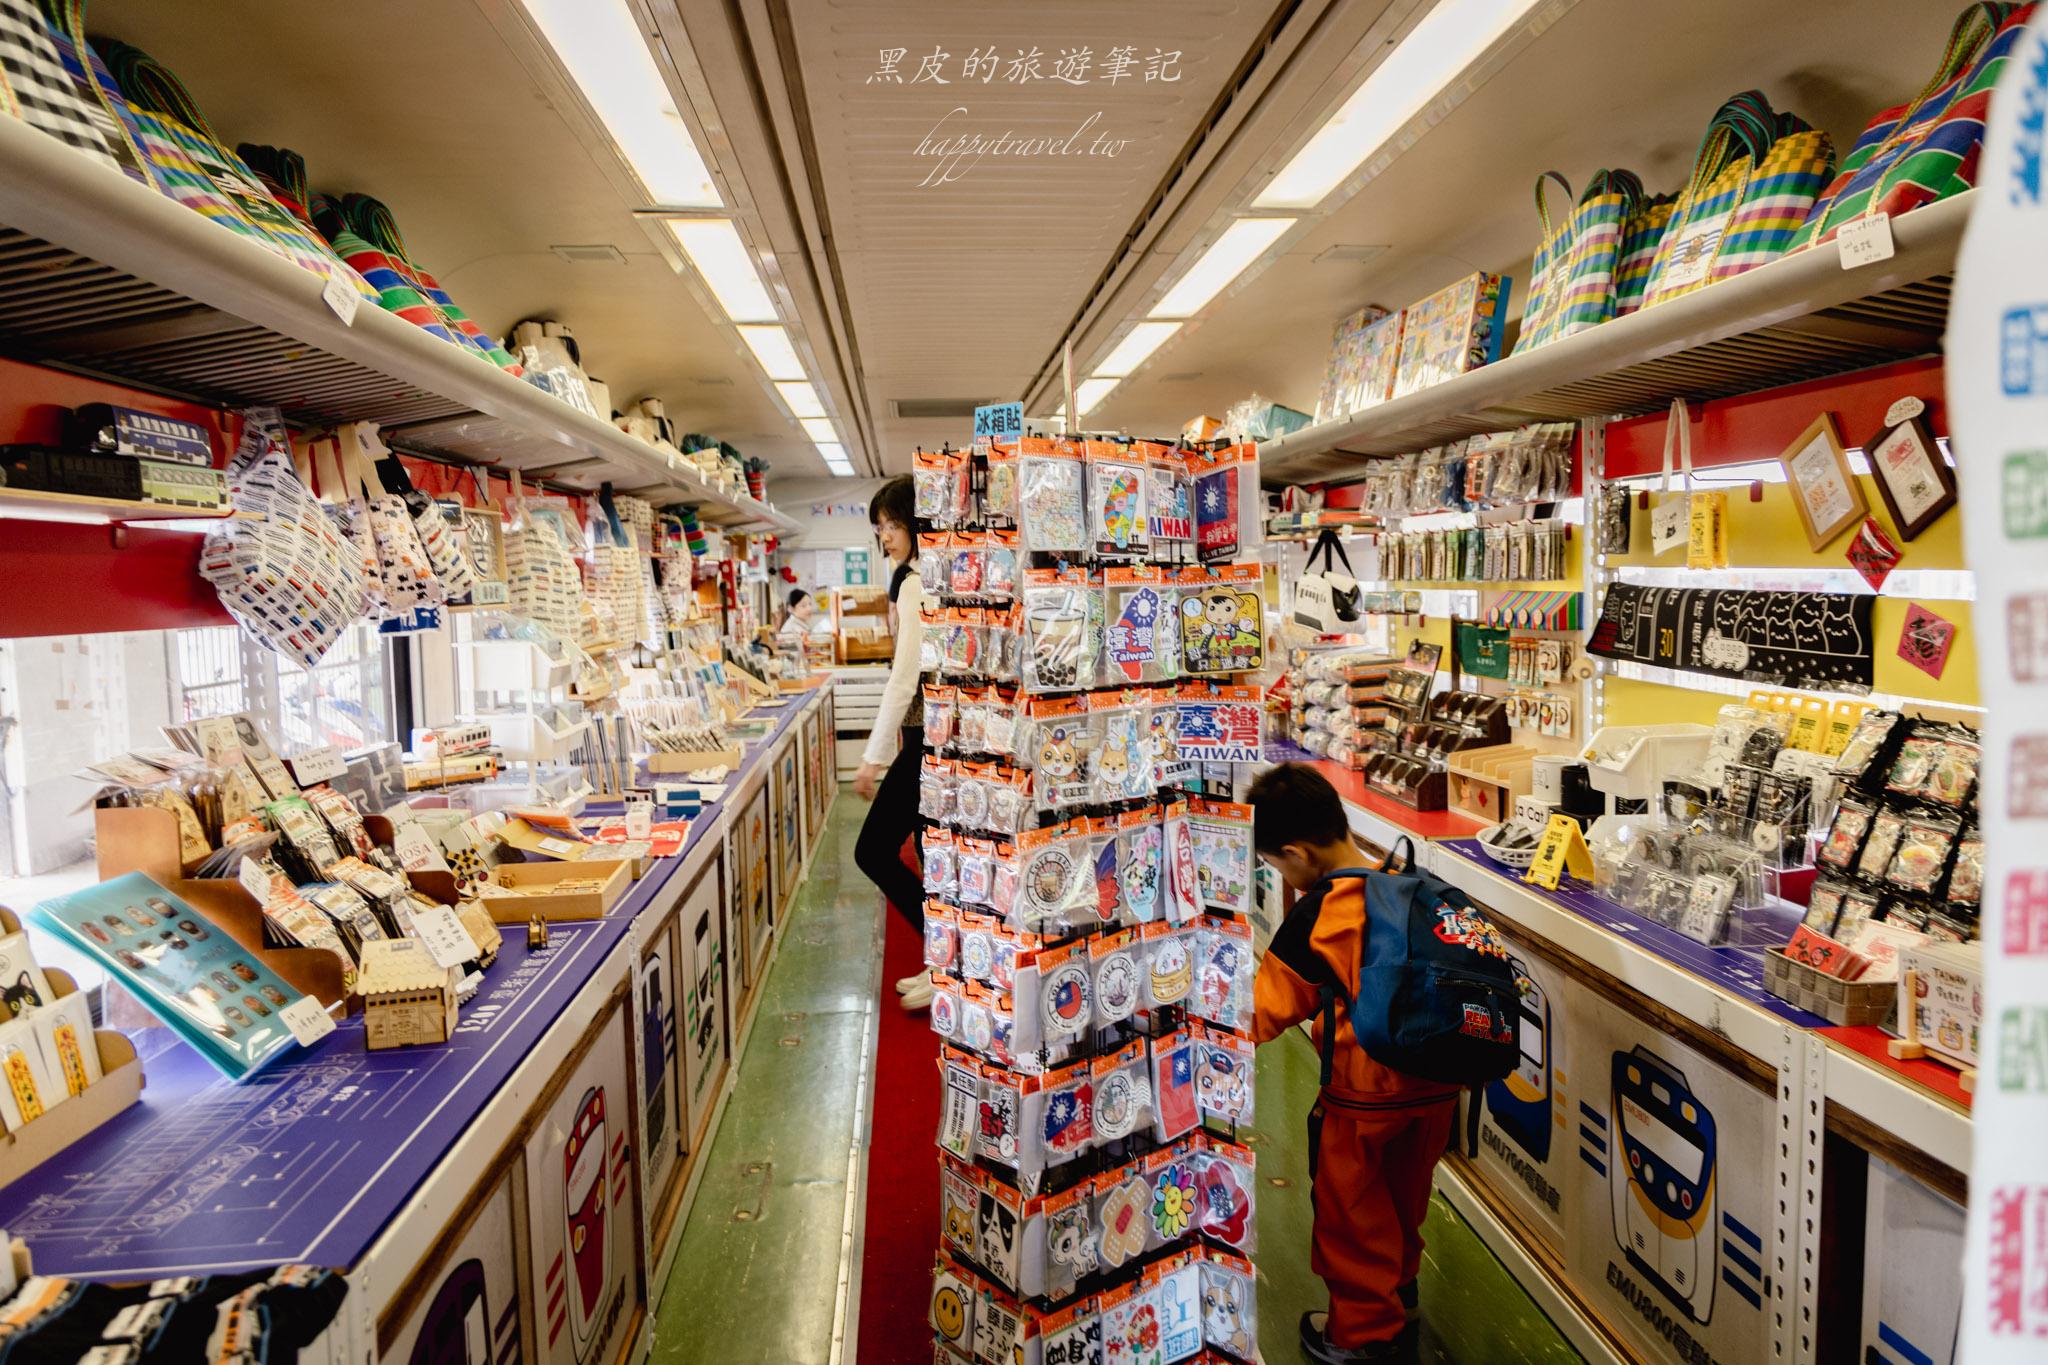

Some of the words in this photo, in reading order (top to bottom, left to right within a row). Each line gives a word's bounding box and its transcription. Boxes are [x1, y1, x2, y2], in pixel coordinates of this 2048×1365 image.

[976, 405, 1021, 434] 冰箱貼
[1149, 516, 1191, 539] AIWAN
[1110, 650, 1154, 662] Taiwan
[1659, 628, 1674, 658] 30
[1177, 704, 1260, 746] 臺灣
[1179, 746, 1259, 761] TAIWAN
